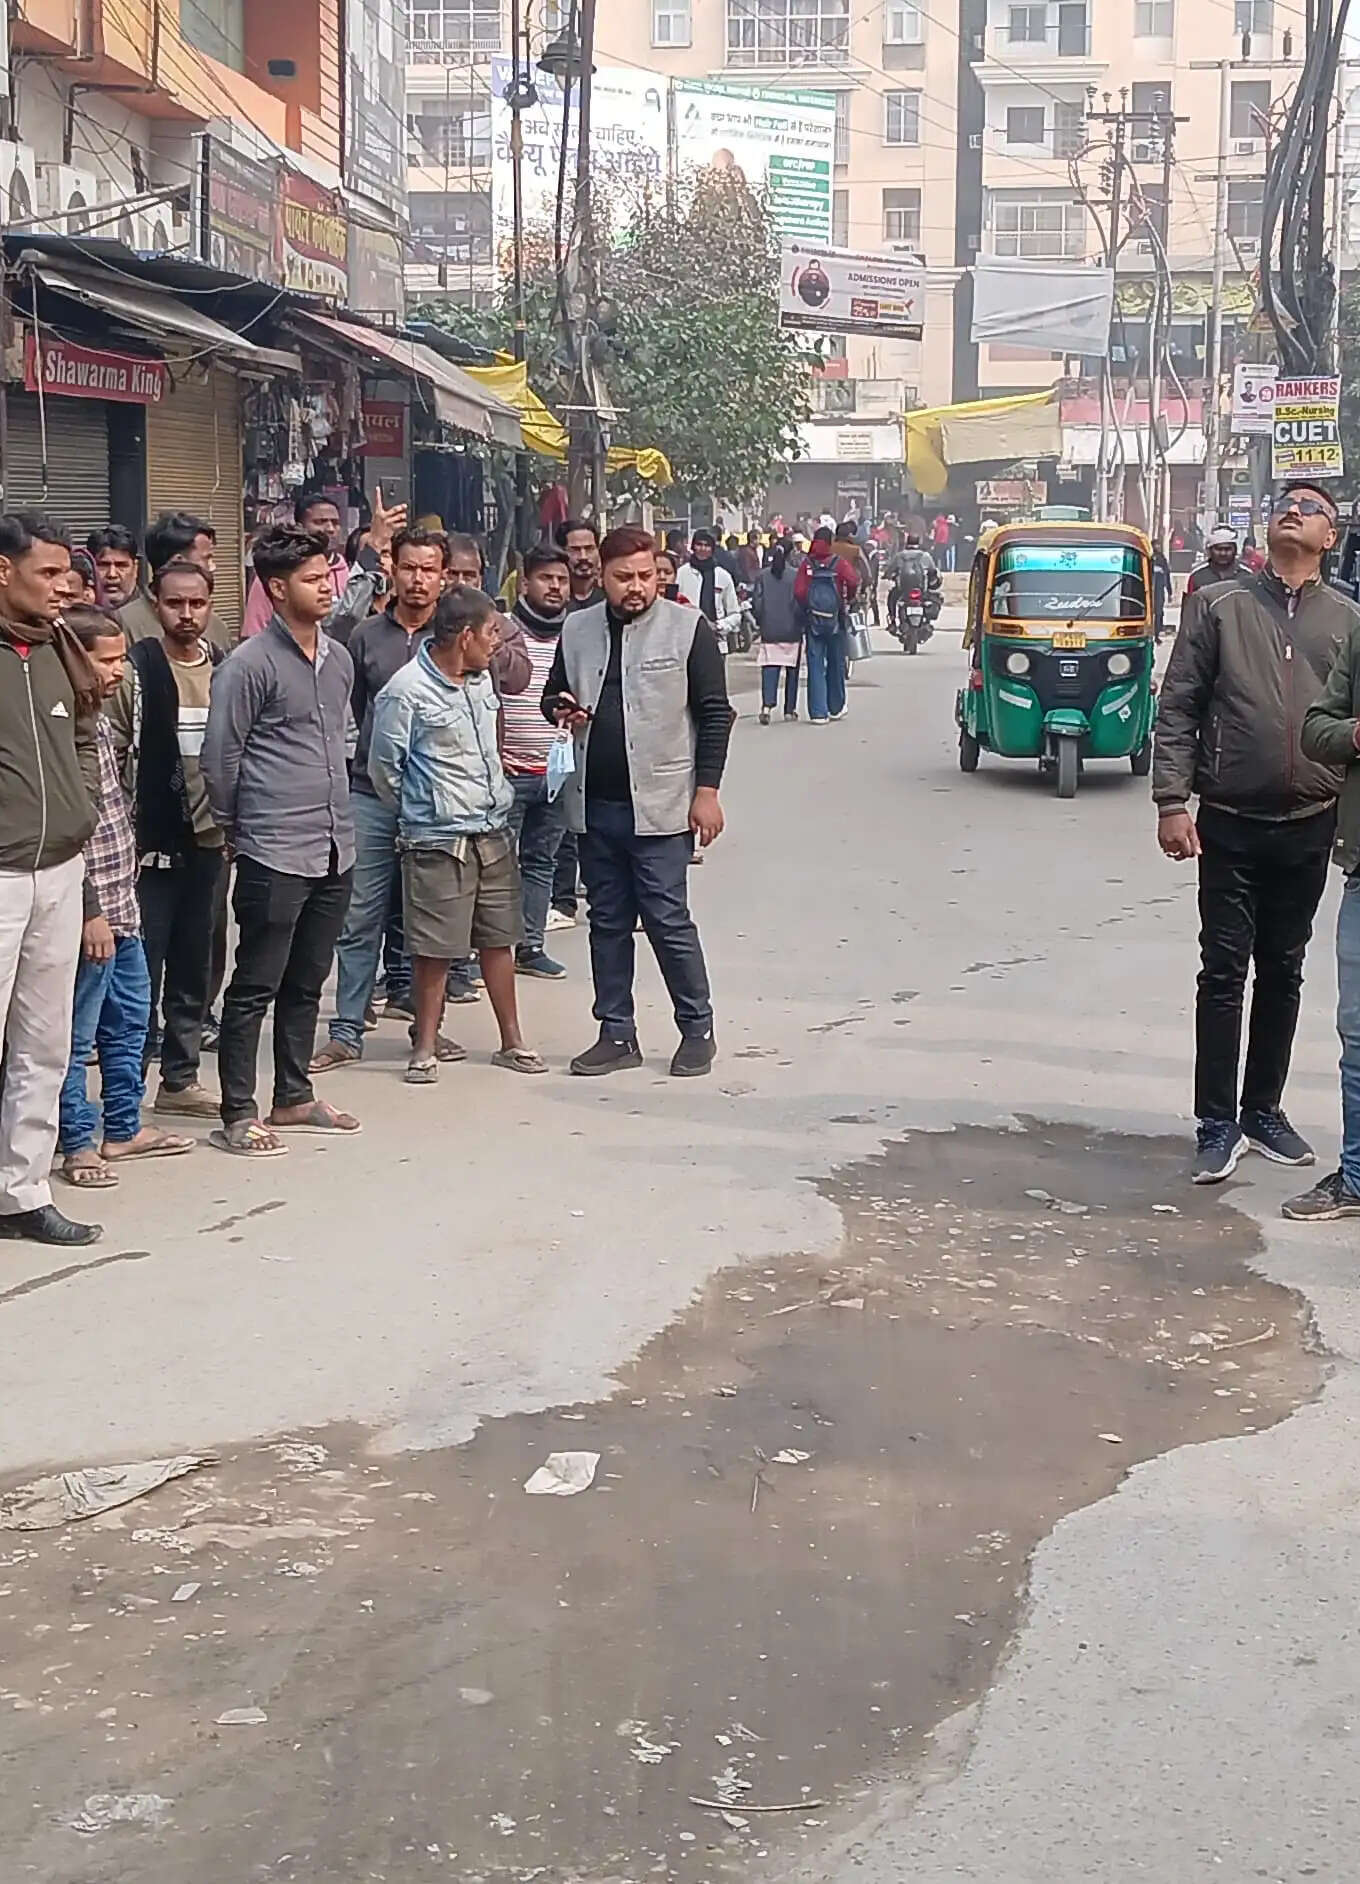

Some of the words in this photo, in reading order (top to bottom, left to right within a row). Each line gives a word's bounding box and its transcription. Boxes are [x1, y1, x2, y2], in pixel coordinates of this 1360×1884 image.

[848, 272, 896, 286] ADMISSIONS
[899, 277, 920, 288] OPEN
[45, 350, 127, 391] Shawarma
[131, 364, 162, 402] King
[1275, 381, 1338, 397] RANKERS
[1275, 421, 1336, 443] CUET
